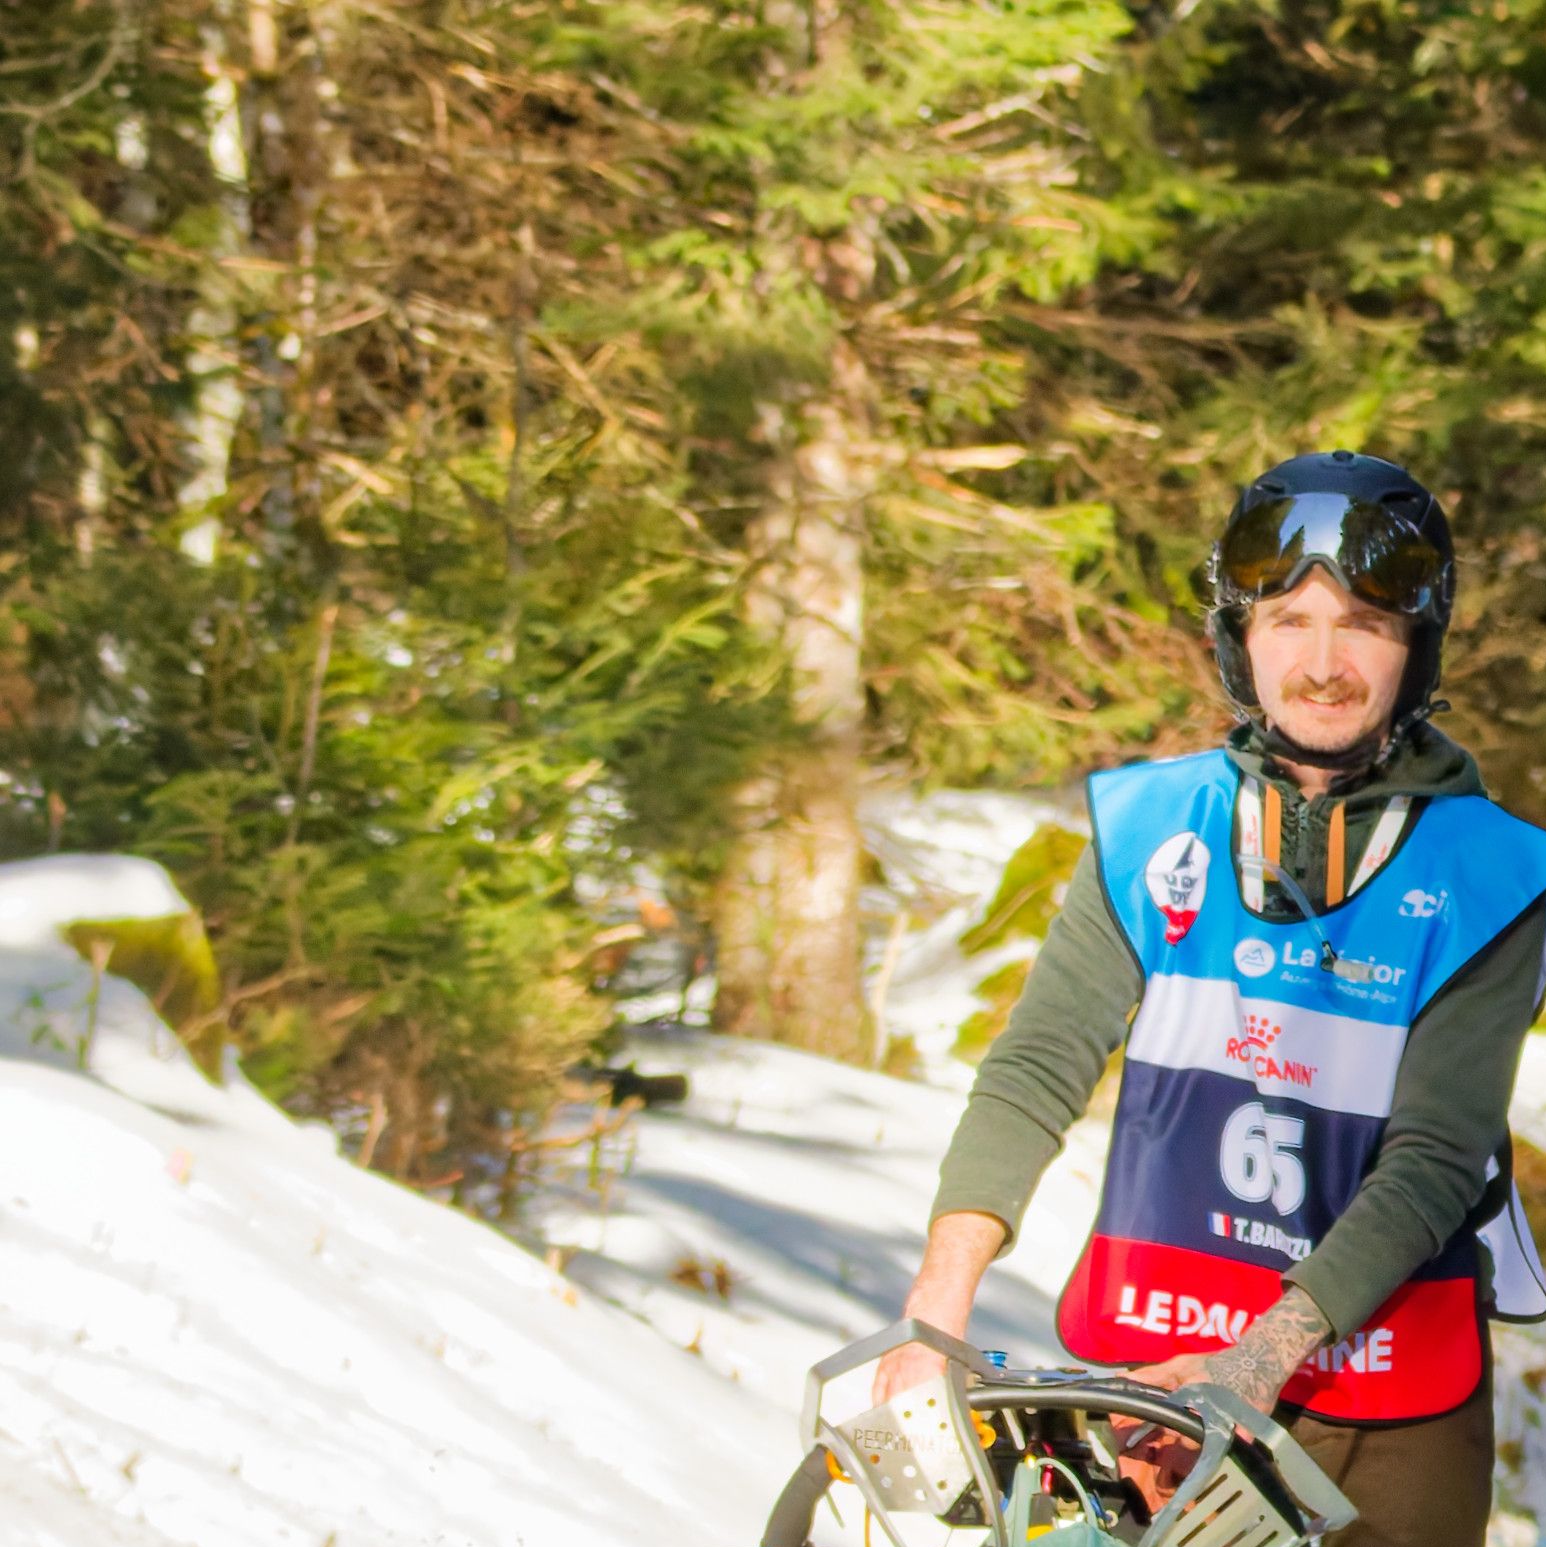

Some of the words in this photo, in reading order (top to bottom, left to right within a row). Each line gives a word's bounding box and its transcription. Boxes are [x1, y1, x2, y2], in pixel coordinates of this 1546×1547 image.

[1281, 942, 1317, 967] La
[1220, 1102, 1306, 1216] 65
[1115, 1285, 1174, 1335] LE
